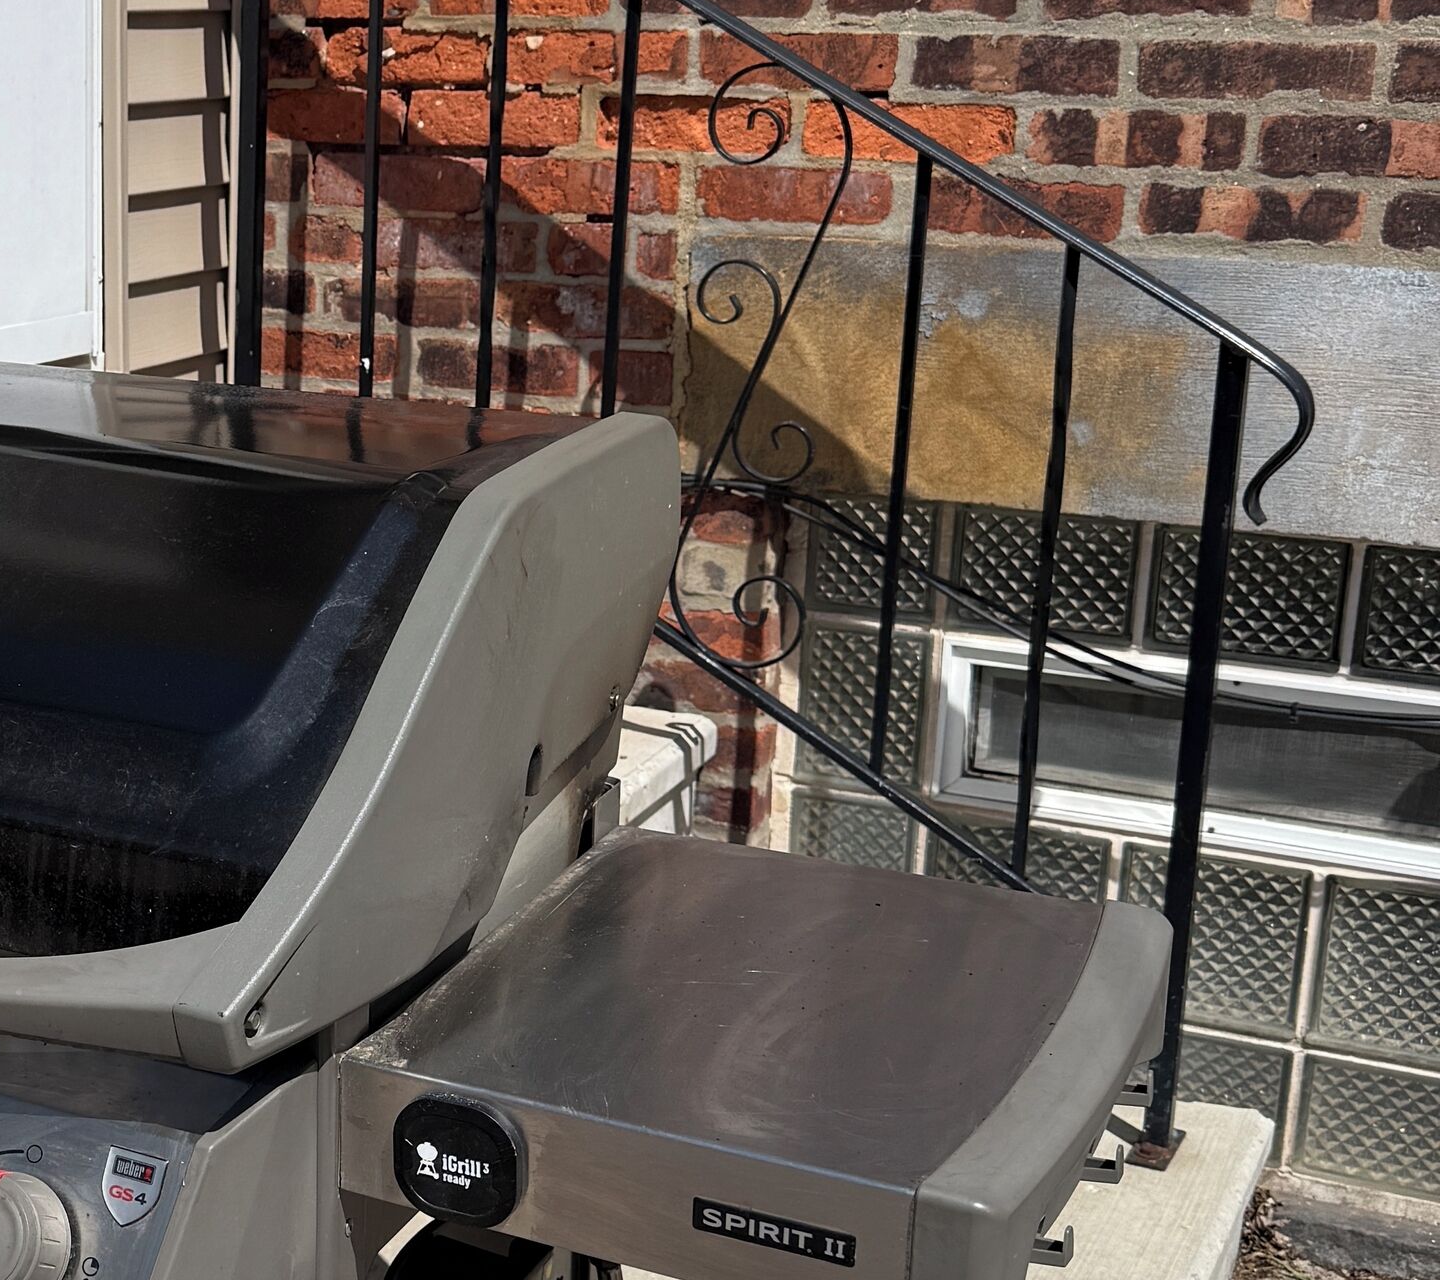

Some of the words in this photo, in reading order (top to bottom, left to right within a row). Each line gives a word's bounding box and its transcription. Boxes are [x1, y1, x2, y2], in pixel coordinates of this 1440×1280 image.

[116, 1160, 145, 1178] weber
[442, 1154, 481, 1178] iGrill
[442, 1173, 471, 1189] ready
[109, 1185, 147, 1205] GS4
[702, 1208, 813, 1249] SPIRIT
[824, 1237, 846, 1259] II
